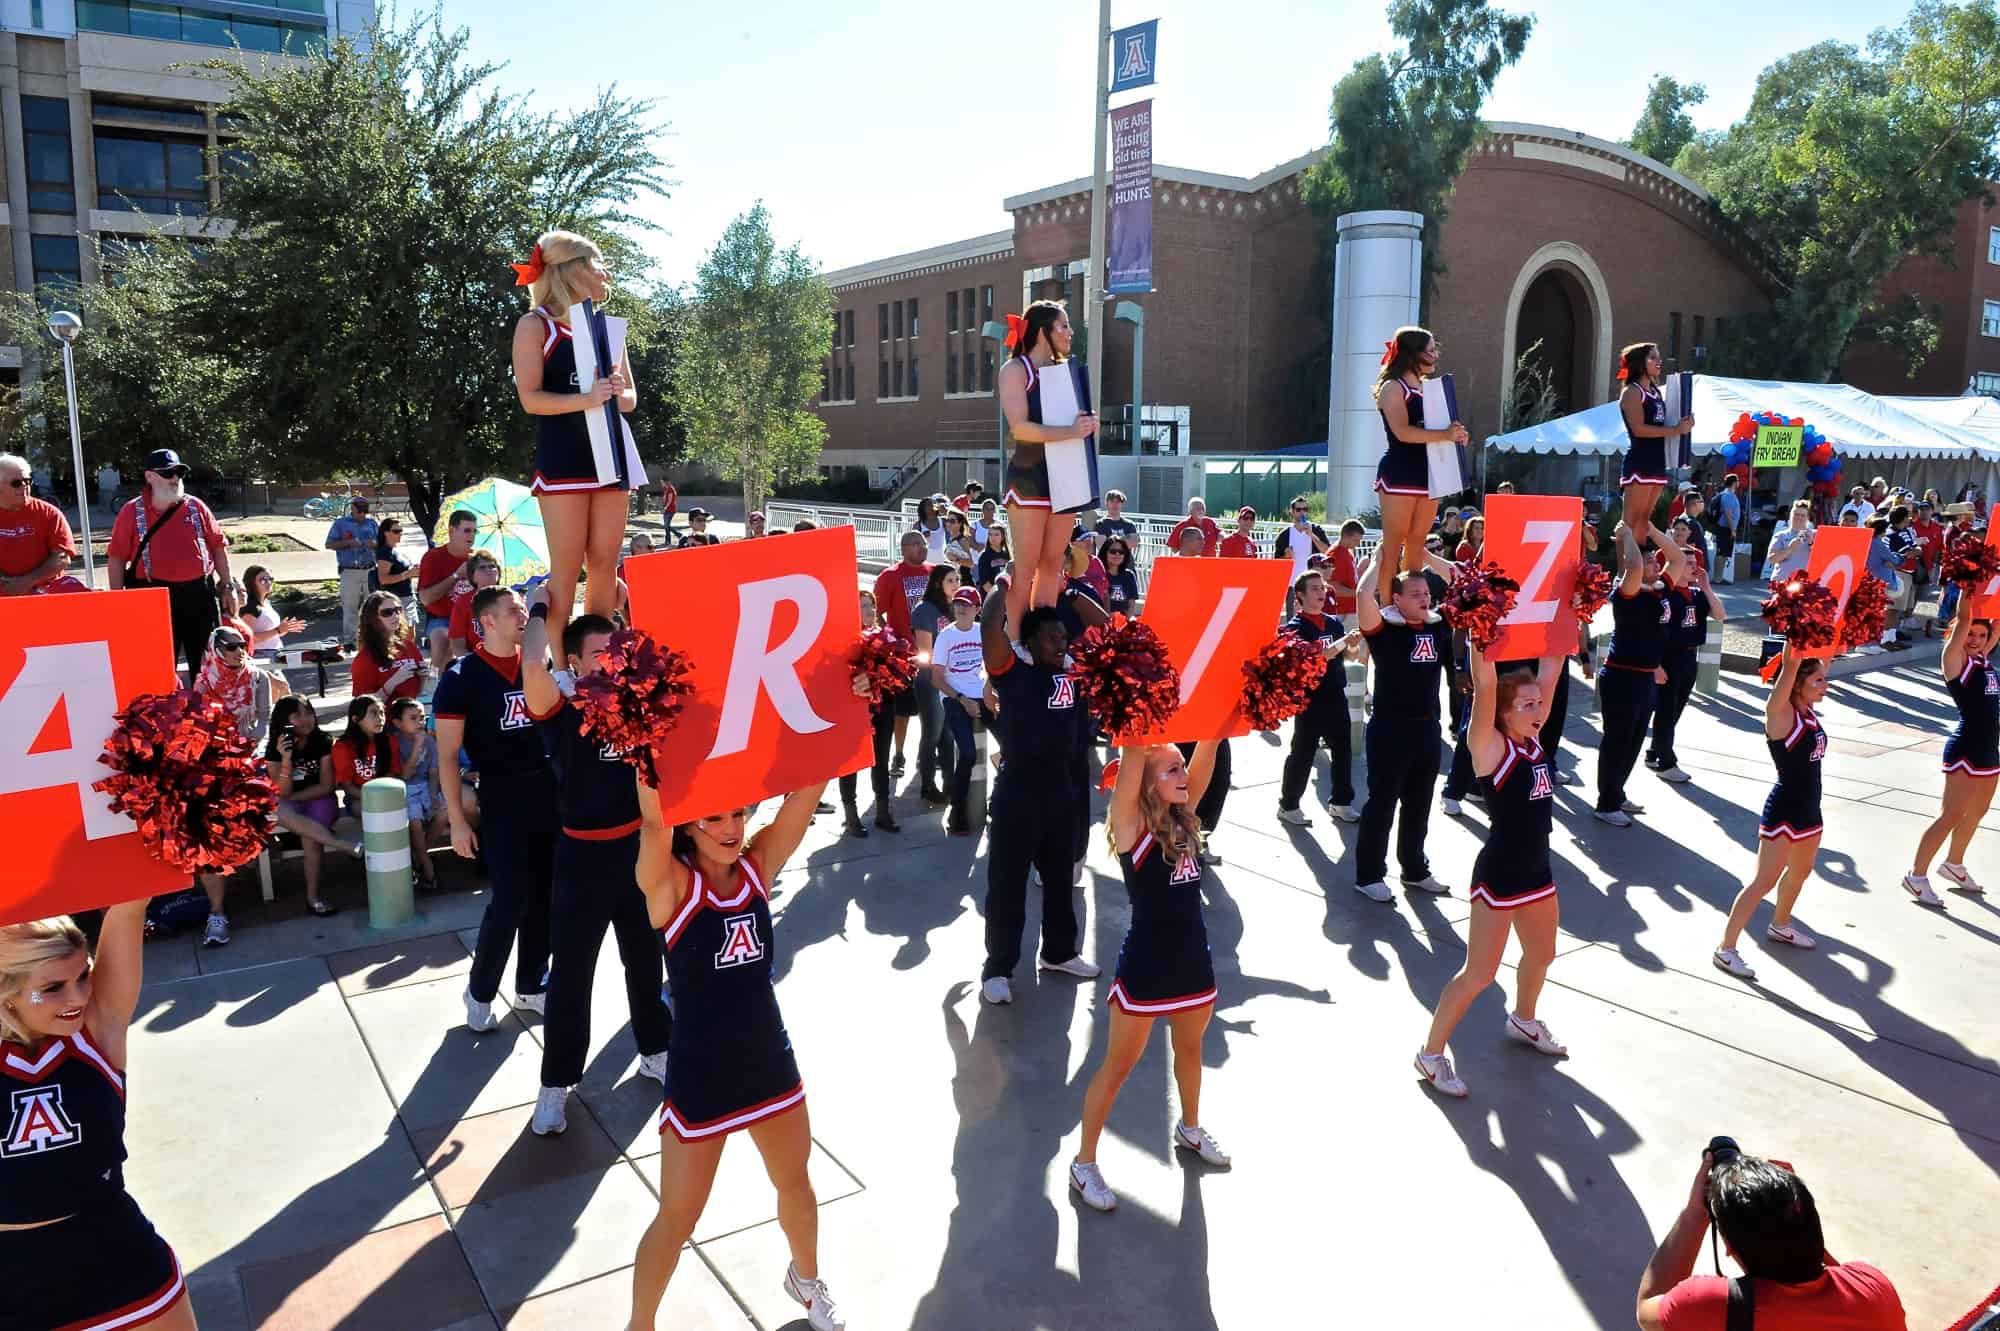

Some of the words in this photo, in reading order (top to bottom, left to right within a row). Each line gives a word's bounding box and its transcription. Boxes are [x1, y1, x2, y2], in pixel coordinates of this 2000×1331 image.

[1118, 32, 1150, 82] A
[1114, 118, 1129, 132] WE
[1131, 112, 1150, 126] ARE
[1114, 129, 1150, 154] fusing
[1115, 150, 1129, 164] old
[1130, 147, 1150, 161] tires
[1756, 447, 1771, 461] FRY
[1772, 447, 1797, 461] BREAD
[1765, 431, 1793, 445] INDIAN
[1496, 520, 1575, 625] Z
[704, 573, 838, 761] R
[1410, 634, 1438, 662] A
[500, 690, 533, 730] A
[1048, 673, 1080, 709] A
[0, 639, 138, 840] A
[1529, 763, 1554, 800] A
[1169, 843, 1201, 885] A
[715, 913, 764, 969] A
[0, 1084, 82, 1159] A
